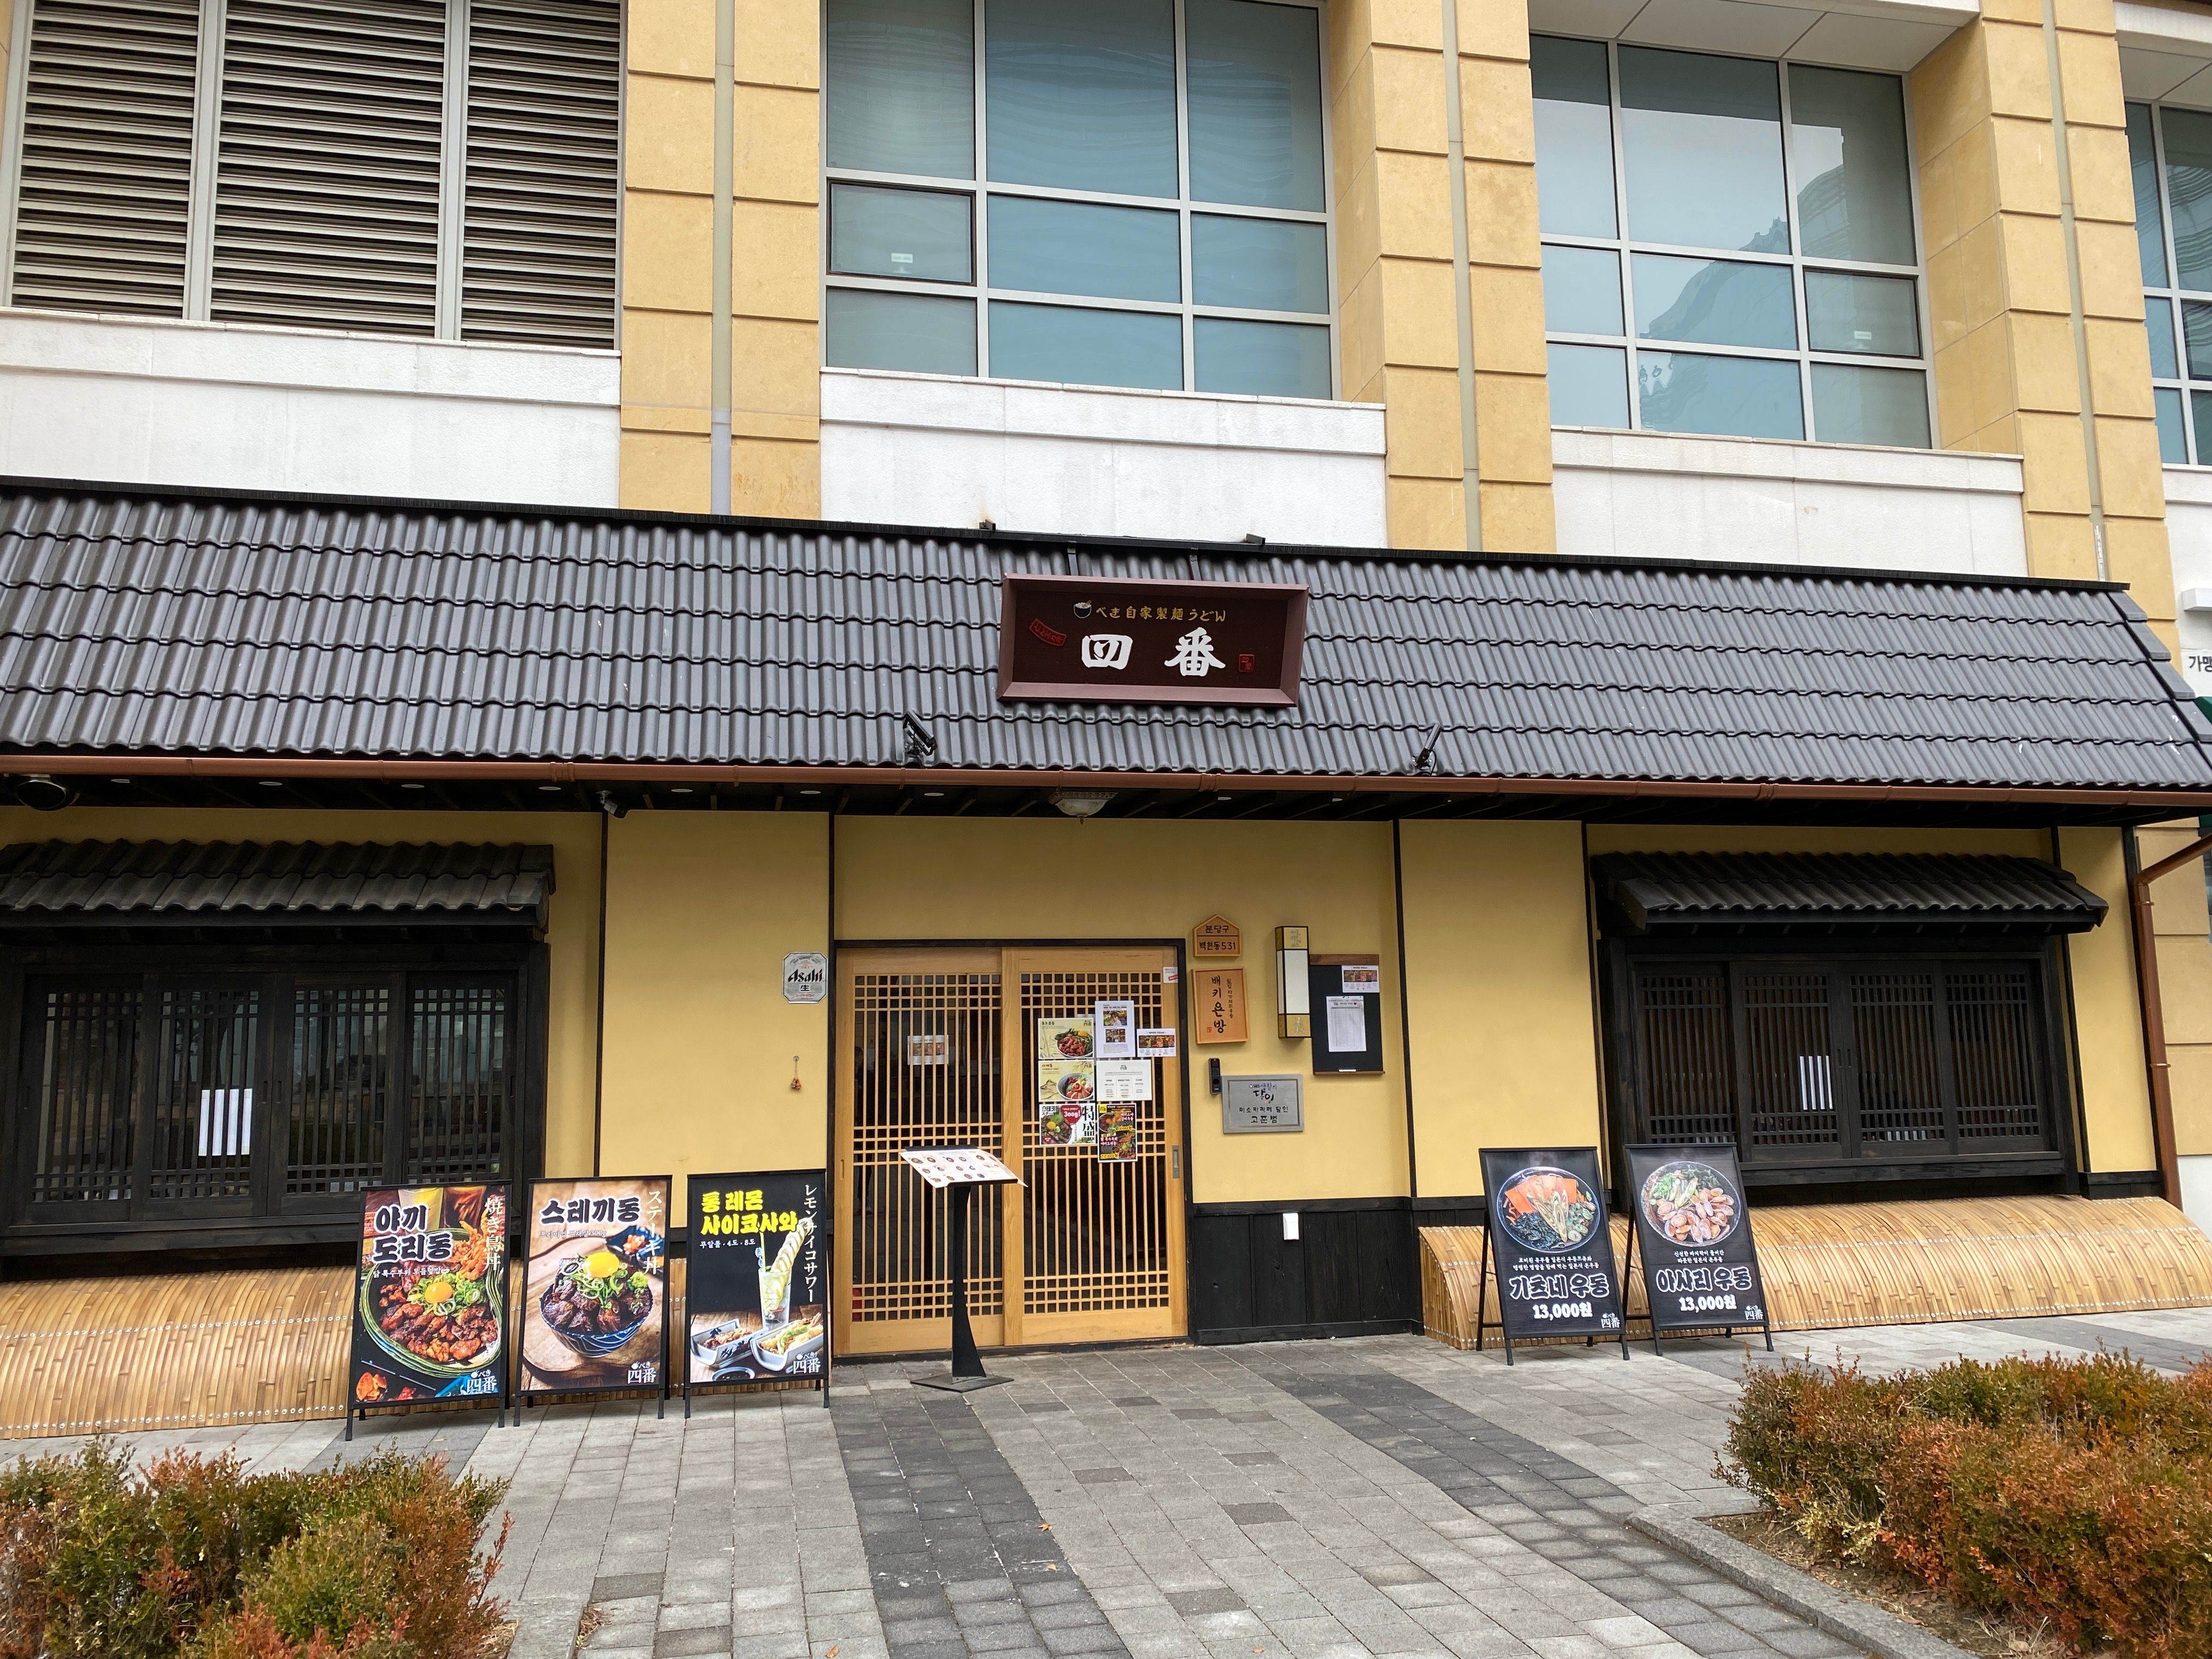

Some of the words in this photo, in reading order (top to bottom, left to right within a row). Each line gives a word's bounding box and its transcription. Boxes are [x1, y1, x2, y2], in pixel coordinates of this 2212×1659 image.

[1082, 627, 1226, 676] 四番
[1205, 925, 1229, 933] 분당구
[788, 969, 822, 982] Asahi
[1251, 1115, 1277, 1124] 고준범
[374, 1203, 428, 1233] 야끼
[540, 1197, 641, 1225] 스테끼동
[642, 1190, 663, 1276] ステーキ丼
[700, 1211, 798, 1235] 사이코사와
[483, 1197, 504, 1272] 焼き鳥丼
[539, 1230, 567, 1238] 프리미엄
[590, 1230, 607, 1238] 300g
[372, 1232, 453, 1264] 도리동
[1509, 1274, 1569, 1300] 기츠네
[1570, 1272, 1610, 1299] 우동
[1656, 1268, 1713, 1293] 아사리
[1713, 1266, 1752, 1291] 우동
[1532, 1301, 1593, 1321] 13,000원
[1678, 1294, 1737, 1313] 13,000원
[1601, 1317, 1621, 1329] 四番
[627, 1367, 656, 1384] 四番
[793, 1358, 821, 1374] 四番
[466, 1375, 497, 1392] 四番
